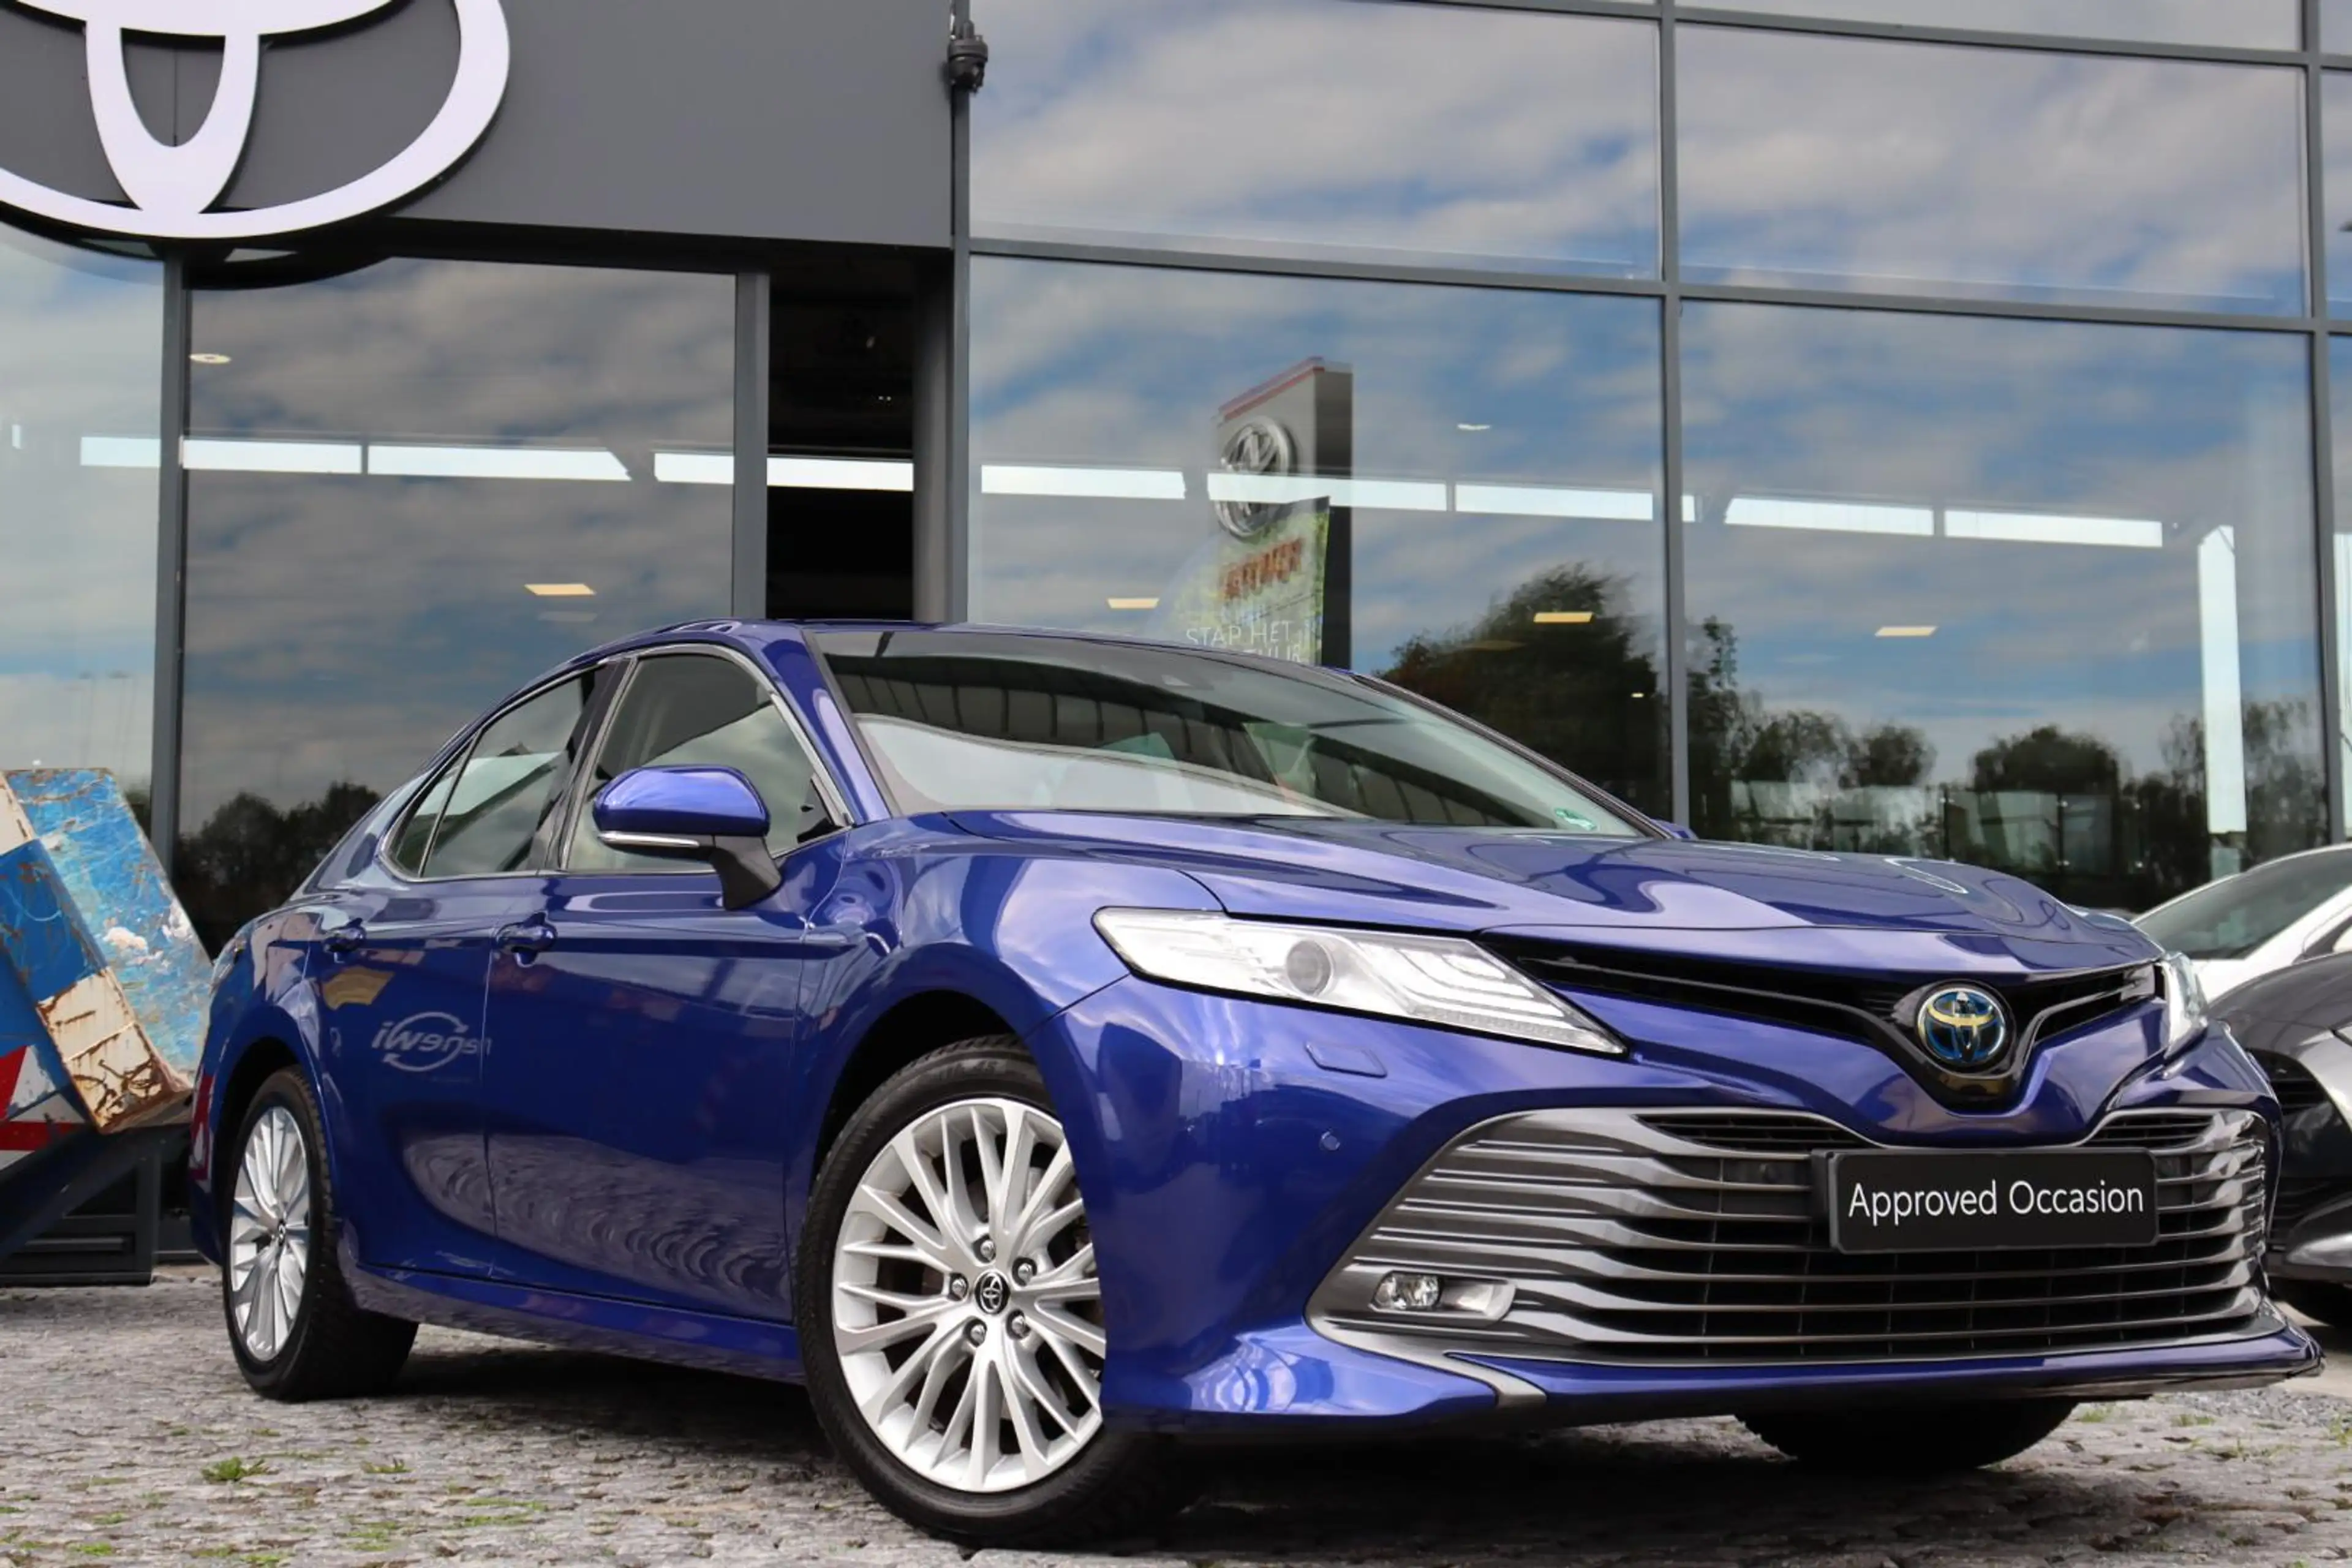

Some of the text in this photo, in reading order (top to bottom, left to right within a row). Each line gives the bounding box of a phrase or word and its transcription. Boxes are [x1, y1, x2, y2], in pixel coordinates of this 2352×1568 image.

[1186, 620, 1294, 648] STAP HET
[1849, 1179, 2144, 1226] Approved Occasion
